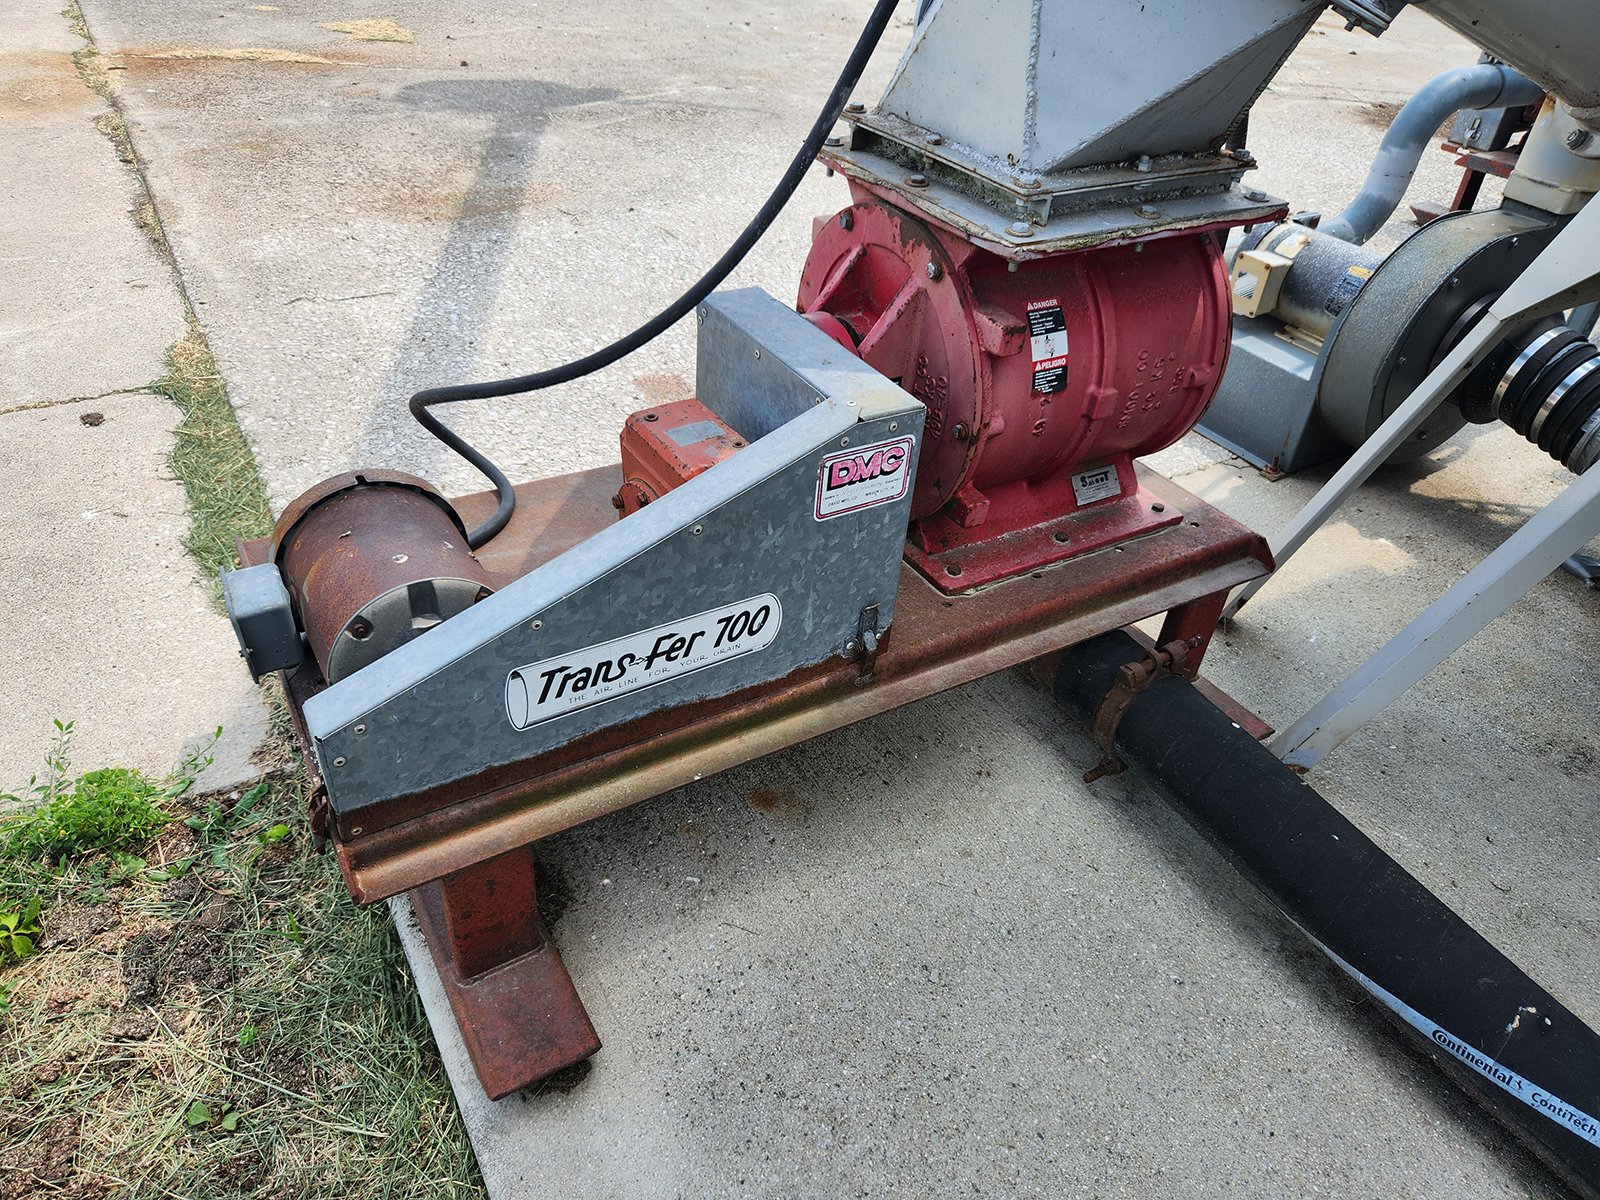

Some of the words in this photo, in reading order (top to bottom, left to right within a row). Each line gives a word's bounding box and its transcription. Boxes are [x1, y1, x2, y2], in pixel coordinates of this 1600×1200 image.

[1033, 299, 1058, 309] DANGER
[1041, 358, 1066, 370] PELIGRO
[827, 446, 905, 491] DMC
[714, 605, 771, 648] 700
[569, 694, 587, 704] THE
[594, 686, 613, 696] AIR
[618, 677, 640, 688] LINE
[649, 667, 670, 678] FOR
[680, 655, 708, 668] YOUR
[713, 643, 741, 657] GRAIN
[1431, 1028, 1513, 1087] Continental
[1531, 1092, 1597, 1137] ContiTech
